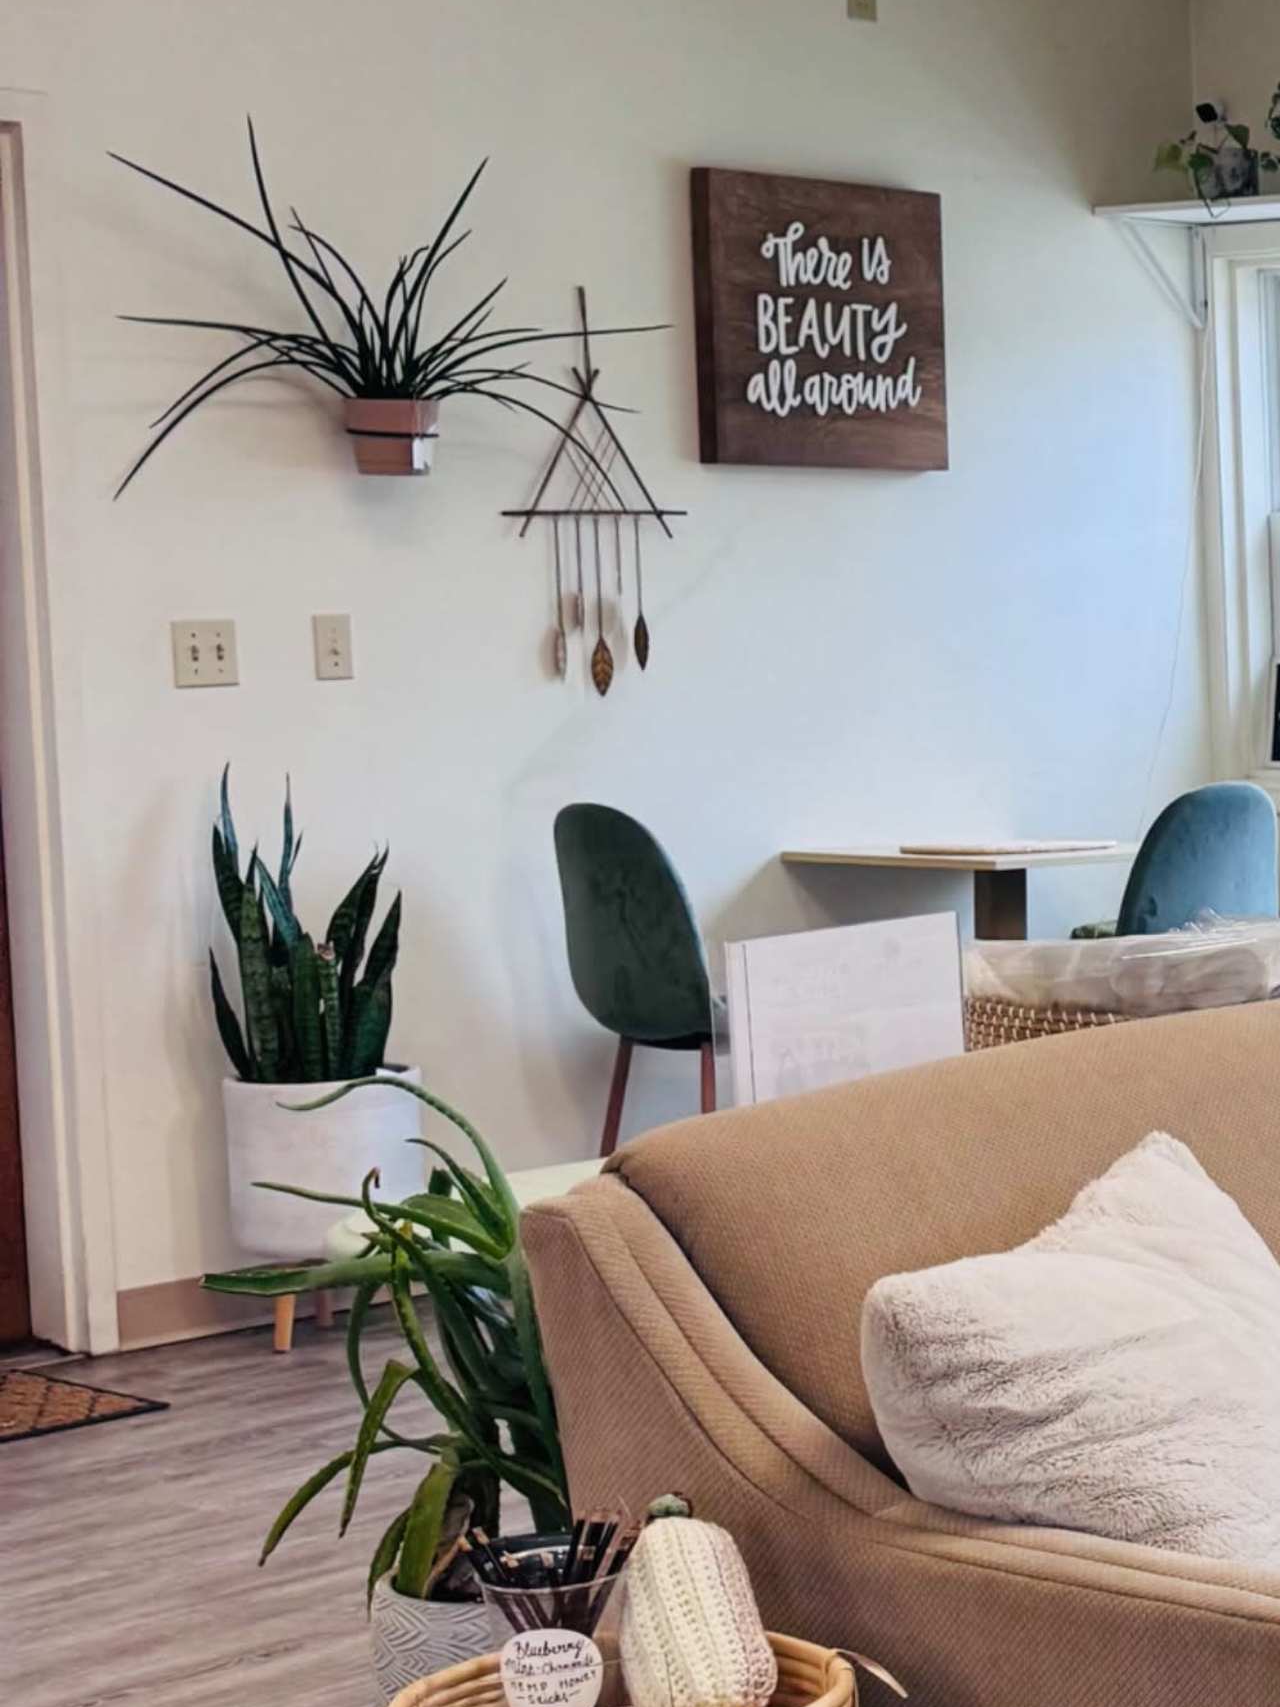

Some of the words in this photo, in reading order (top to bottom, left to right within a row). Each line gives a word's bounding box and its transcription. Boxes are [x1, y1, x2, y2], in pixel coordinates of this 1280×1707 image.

[761, 222, 852, 290] There
[757, 294, 907, 363] BEAUTY
[513, 1639, 584, 1659] Blueberry
